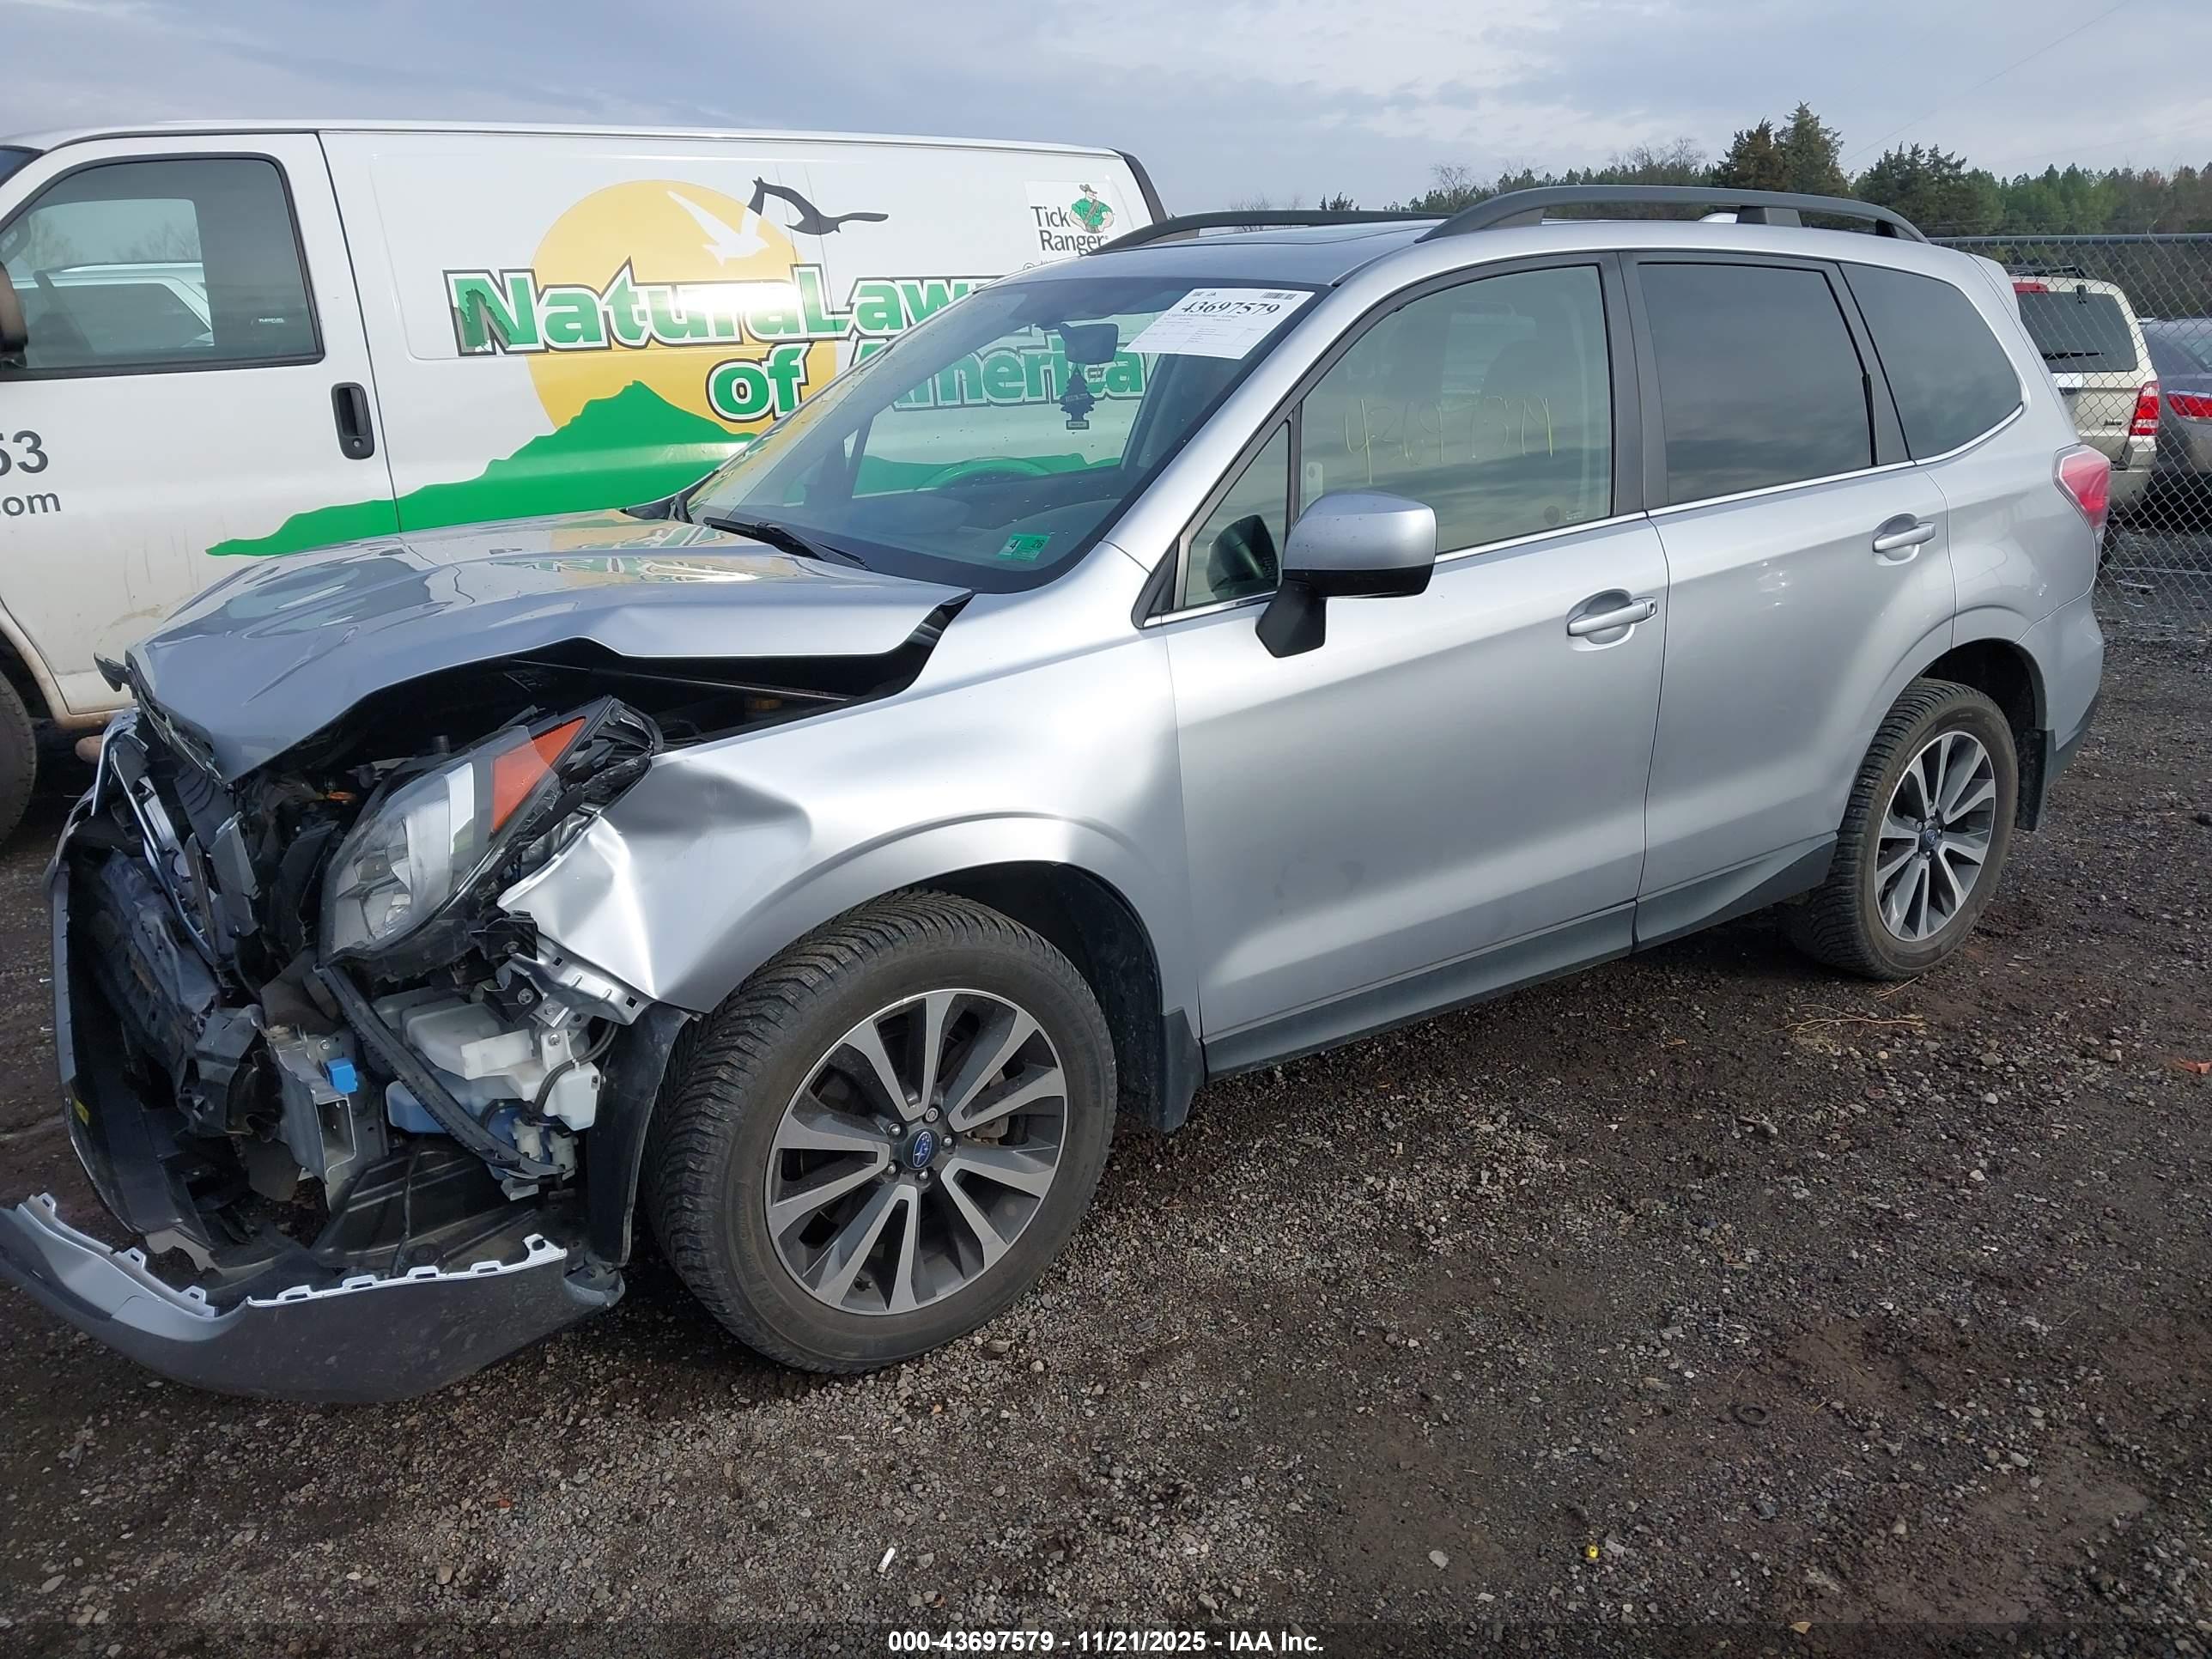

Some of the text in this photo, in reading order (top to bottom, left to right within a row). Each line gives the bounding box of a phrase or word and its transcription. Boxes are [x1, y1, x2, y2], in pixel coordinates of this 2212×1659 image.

[1030, 205, 1071, 227] Tick
[442, 256, 1006, 355] NaturaLaw
[1181, 301, 1281, 317] 43697579
[704, 342, 809, 423] of
[0, 492, 62, 517] om
